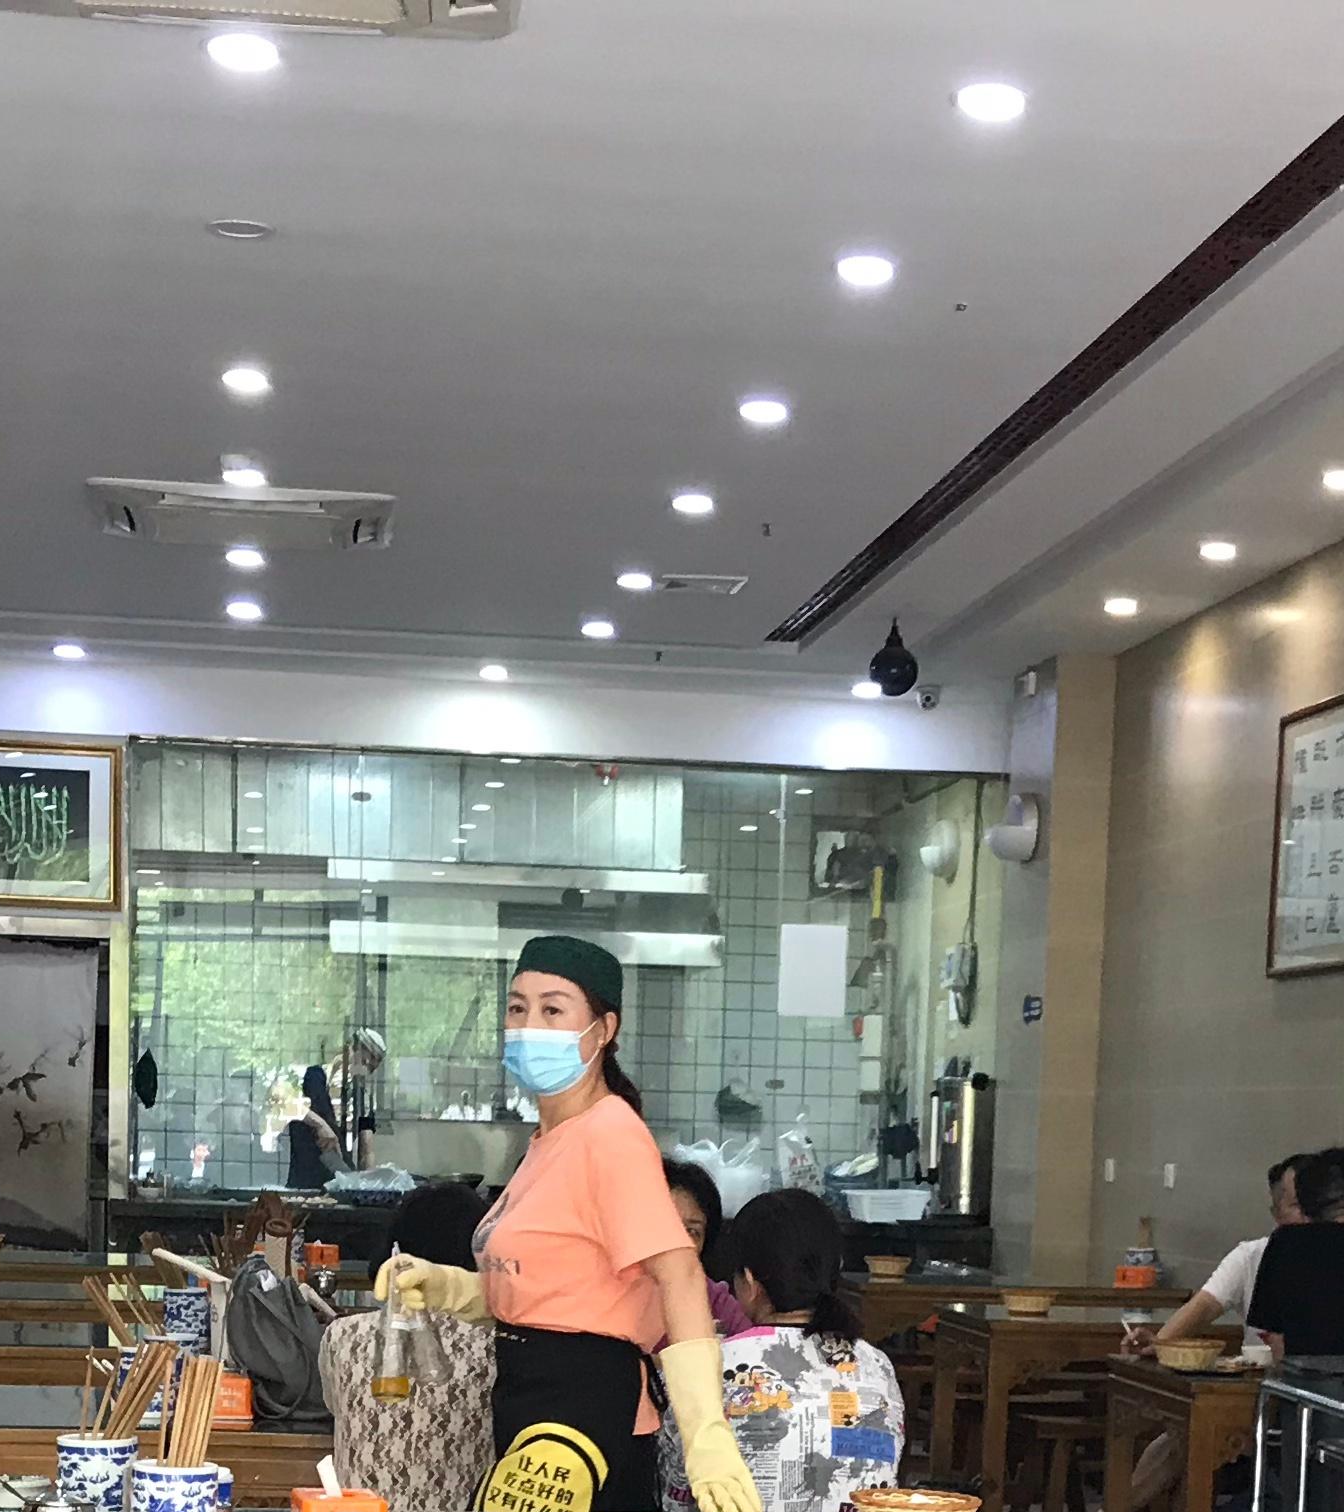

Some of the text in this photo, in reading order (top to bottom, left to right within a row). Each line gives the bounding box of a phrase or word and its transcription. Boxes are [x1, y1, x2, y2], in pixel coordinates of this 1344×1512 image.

[517, 1454, 571, 1484] 让人民
[503, 1471, 575, 1506] 吃点好的
